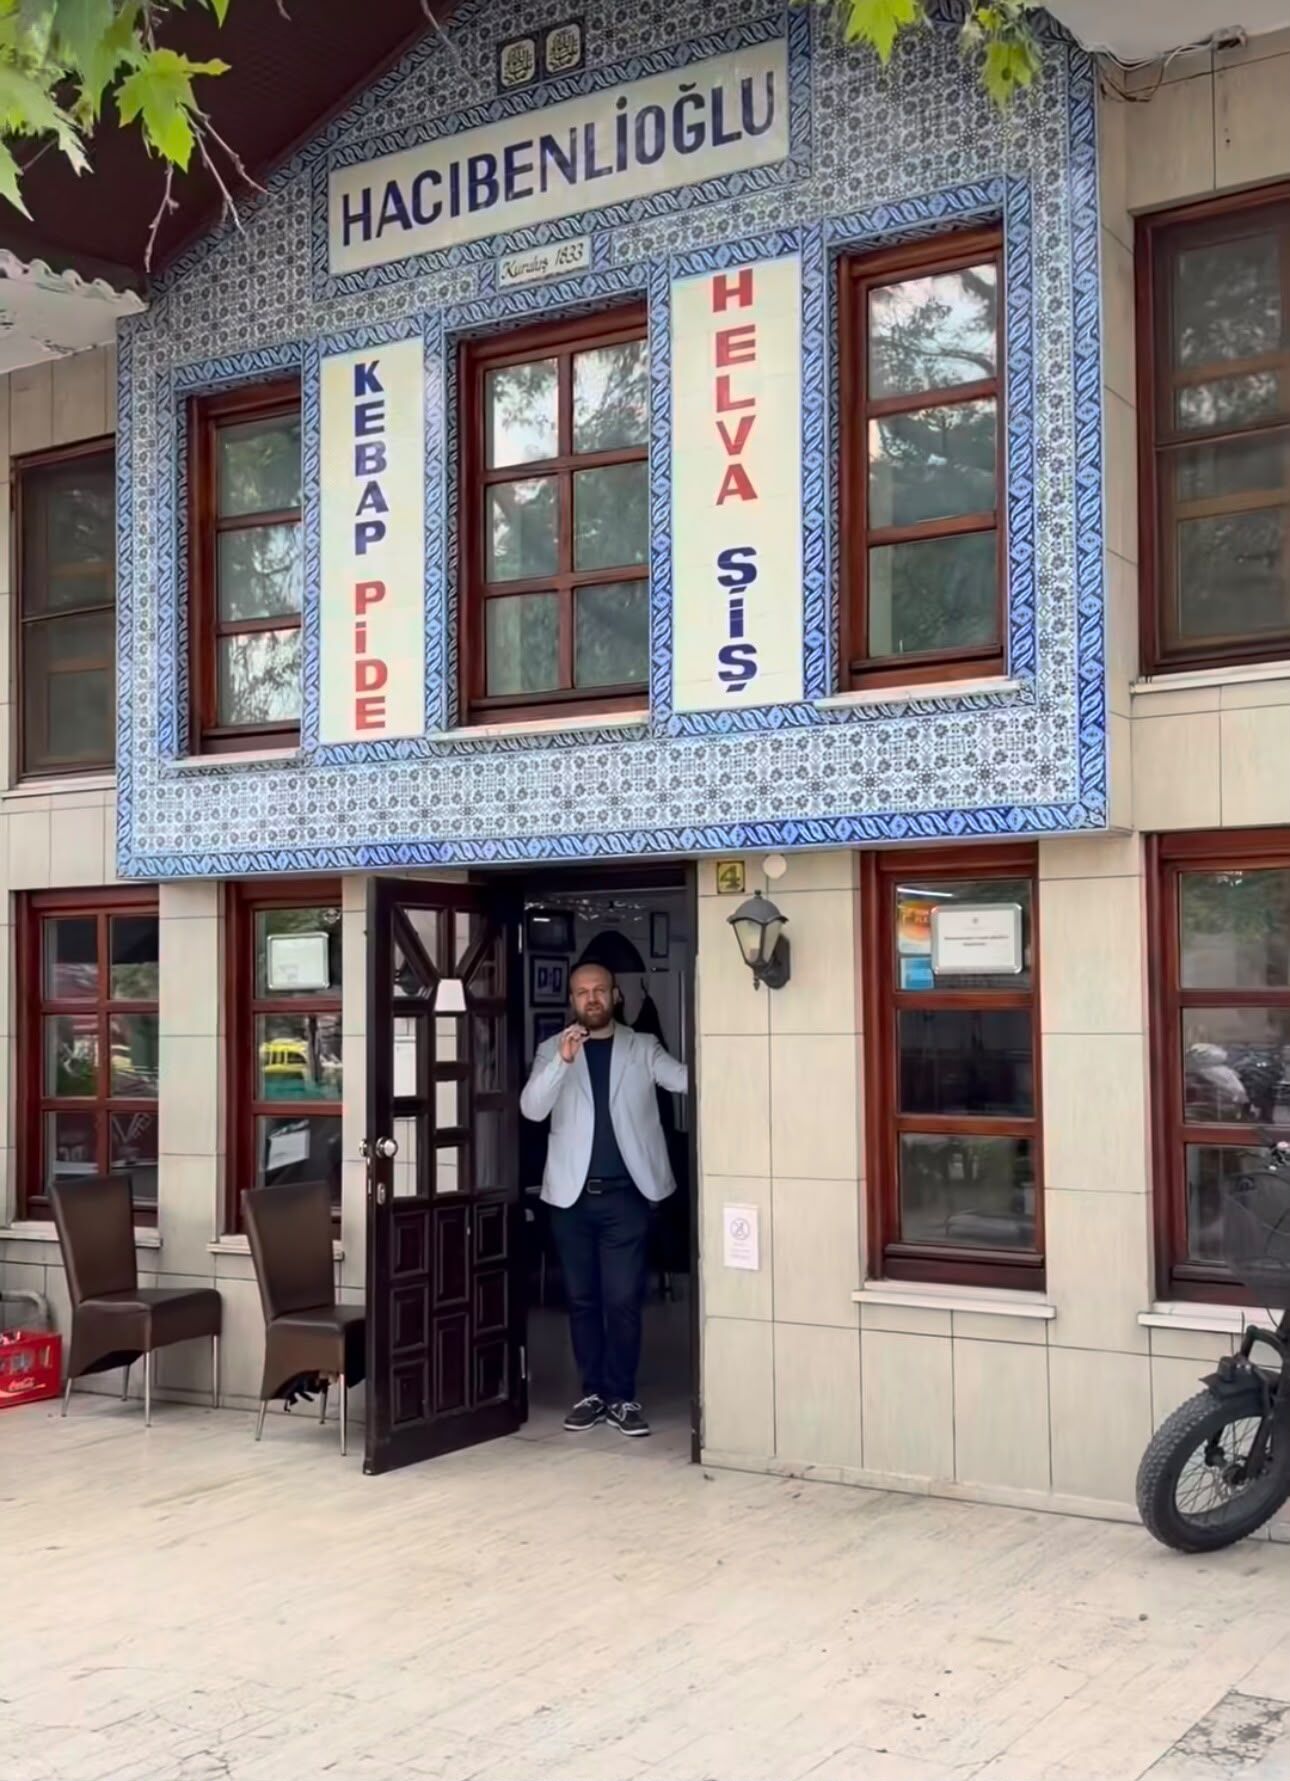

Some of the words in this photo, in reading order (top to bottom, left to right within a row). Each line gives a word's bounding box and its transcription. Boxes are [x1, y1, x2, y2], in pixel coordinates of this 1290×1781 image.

[342, 71, 776, 246] HACIBENLİOĞLU
[555, 242, 584, 266] 1833
[354, 360, 389, 555] KEBAP
[712, 268, 758, 507] HELVA
[354, 580, 389, 731] PİDE
[716, 546, 759, 693] ŞİŞ
[719, 864, 741, 888] 4
